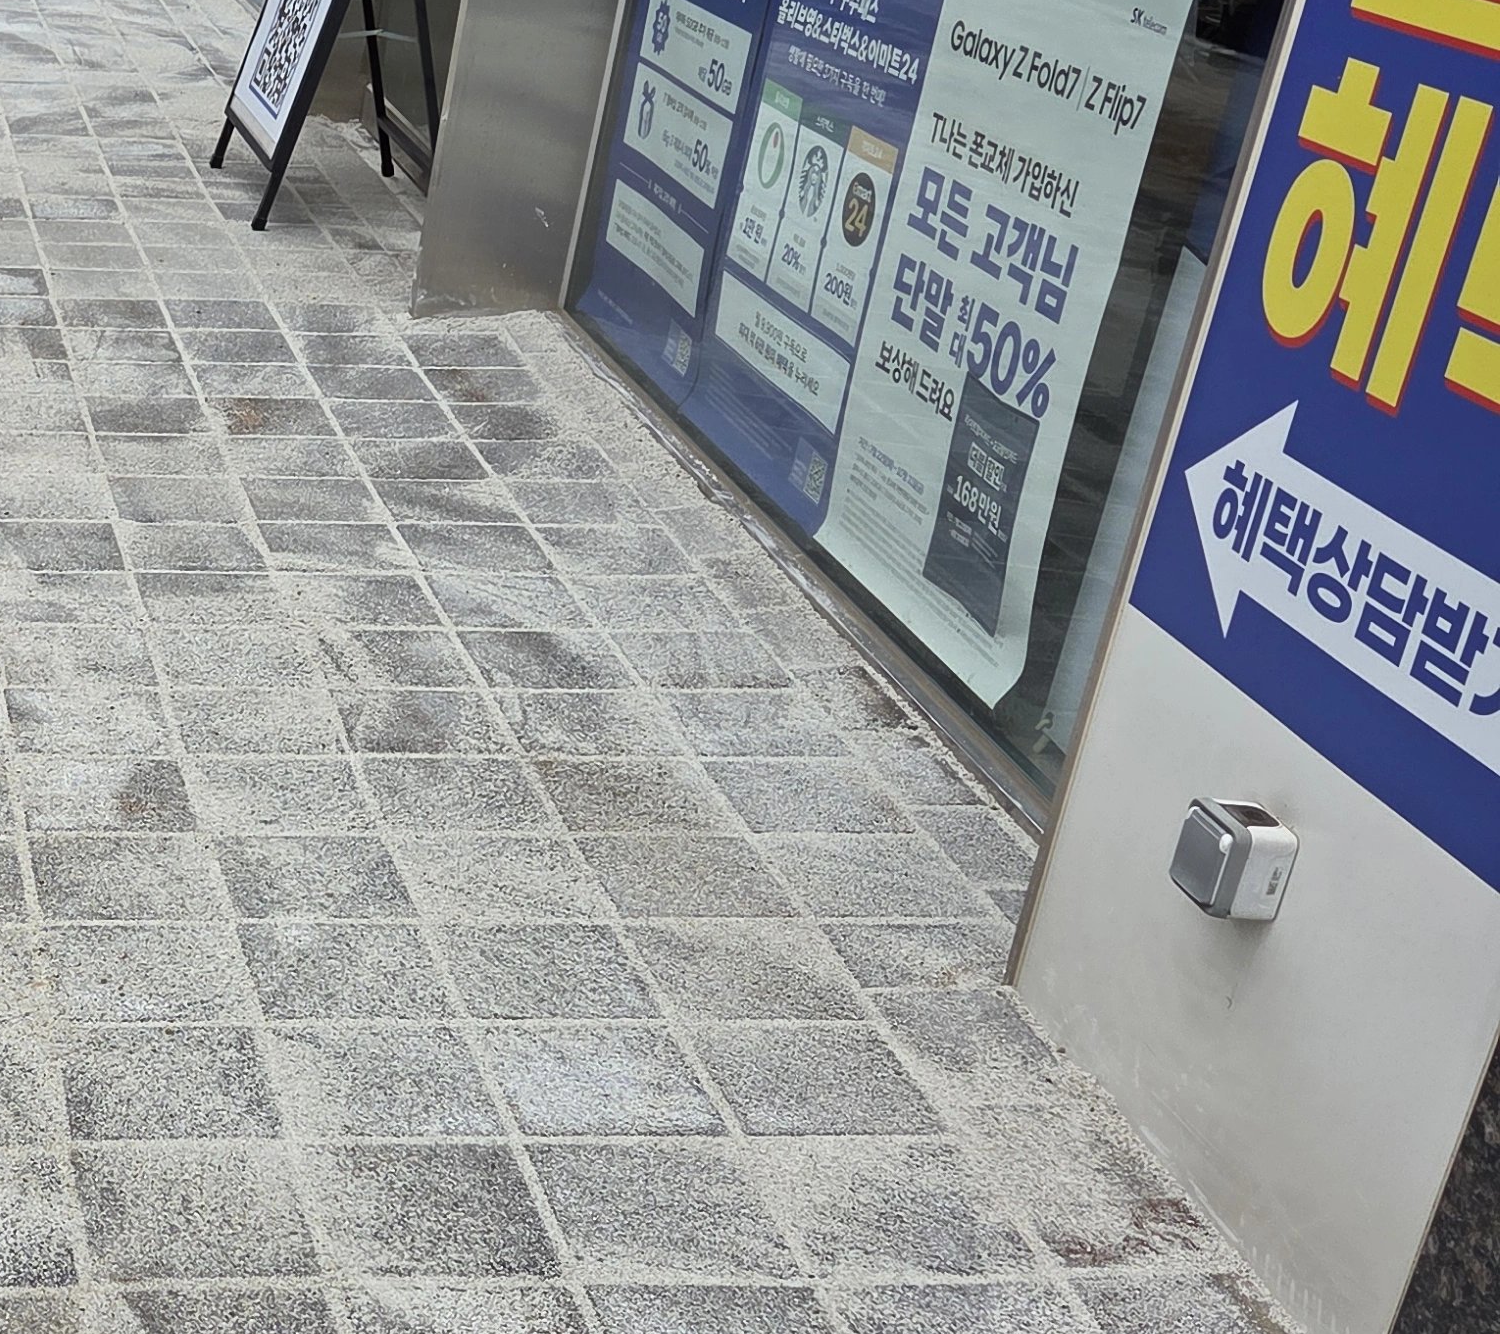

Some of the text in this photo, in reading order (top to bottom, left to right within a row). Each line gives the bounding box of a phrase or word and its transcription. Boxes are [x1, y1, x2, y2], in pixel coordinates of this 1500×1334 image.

[1130, 7, 1145, 25] SK
[950, 20, 1148, 136] Galaxy Z Fold7 Z Flip7
[844, 198, 870, 238] 24
[1011, 156, 1081, 219] 가입하신
[906, 166, 1080, 325] 모든 고객님
[890, 253, 955, 354] 단말
[966, 301, 1057, 419] 50%
[874, 340, 956, 422] 보상해 드려요
[953, 475, 1002, 536] 168만원
